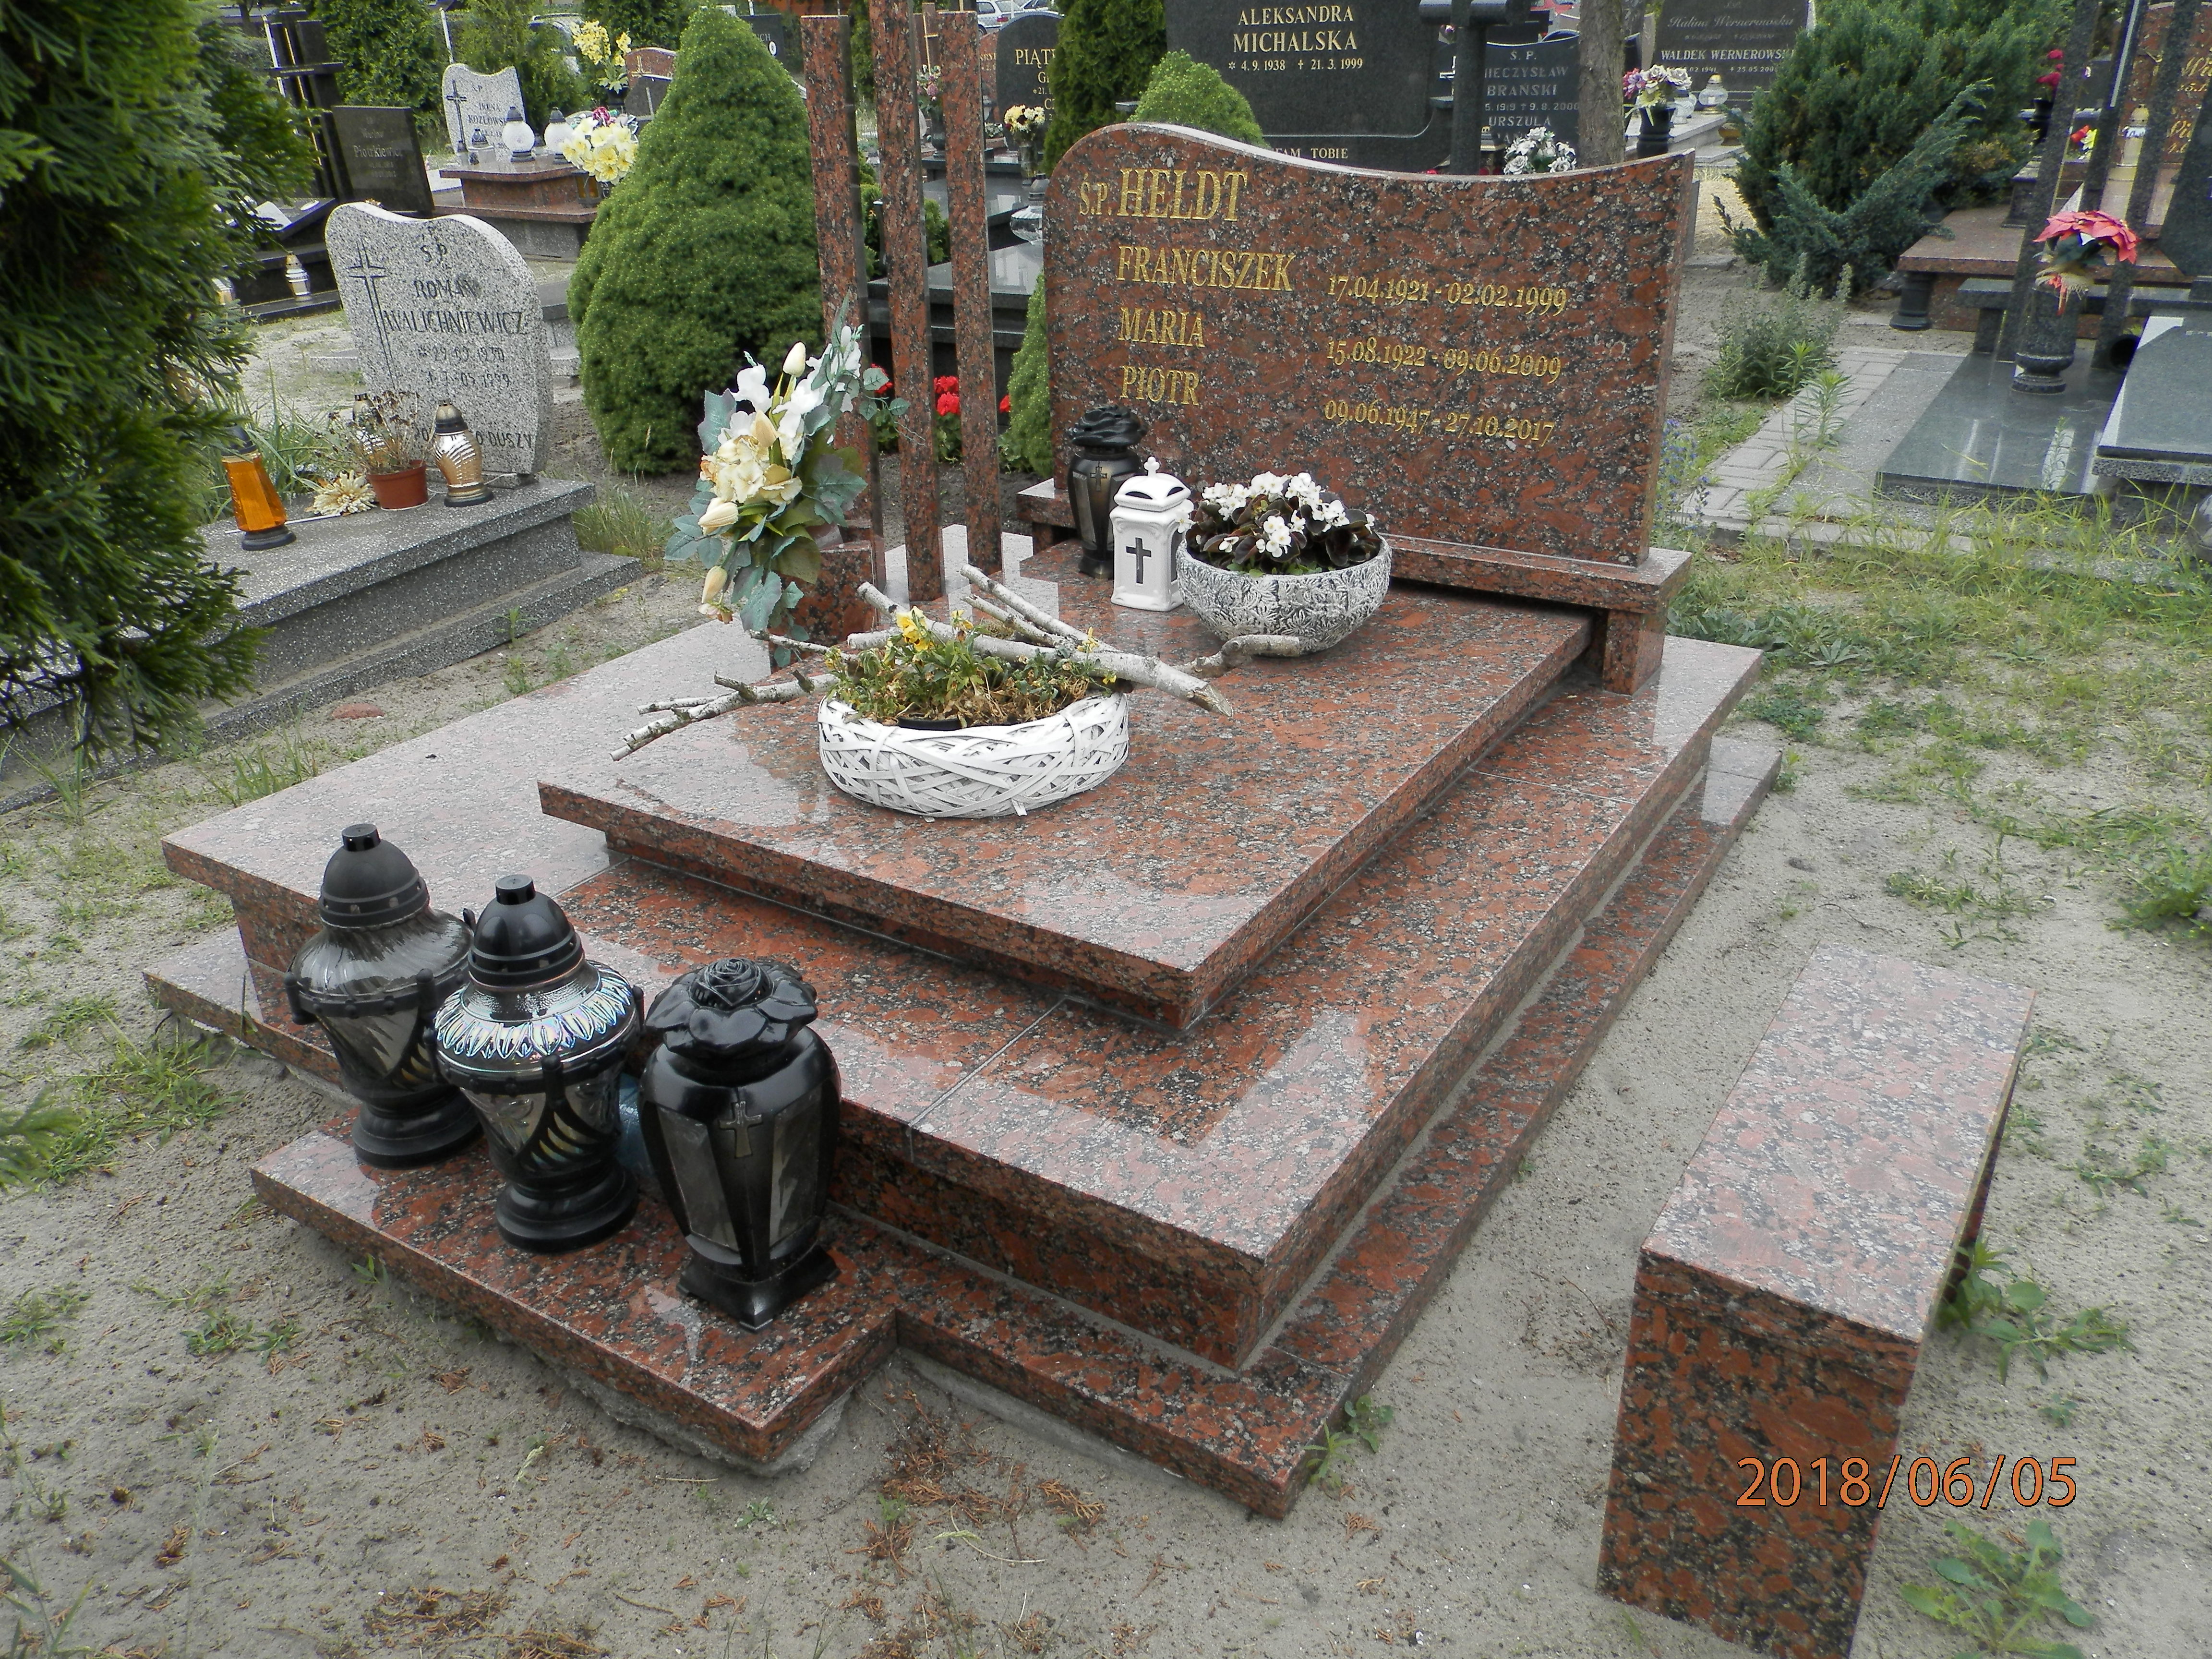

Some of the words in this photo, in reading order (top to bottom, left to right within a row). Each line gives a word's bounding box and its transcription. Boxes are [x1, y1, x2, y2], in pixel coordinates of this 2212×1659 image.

[1238, 5, 1354, 25] ALEKSANDRA
[1233, 30, 1357, 53] MICHALSKA
[1015, 49, 1056, 69] PIĄT
[1264, 60, 1286, 71] 1938
[1341, 58, 1363, 69] 1999
[1661, 49, 1707, 60] WALDEK
[1489, 116, 1551, 127] URSZULA
[1310, 148, 1348, 159] TOBIE
[1117, 168, 1248, 222] HELDT
[414, 280, 478, 300] ROMAN
[1117, 245, 1296, 291] FRANCISZEK
[1327, 276, 1429, 305] 17.04.1921
[1447, 282, 1567, 317] 02.02.1999
[1118, 307, 1205, 348] MARIA
[1326, 337, 1427, 371] 15.08.1922
[1443, 347, 1562, 385] 09.06.2009
[1120, 365, 1200, 406] PIOTR
[1324, 399, 1431, 434] 09.06.1947
[1445, 411, 1556, 447] 27.10.2017
[488, 432, 532, 448] DUSZY
